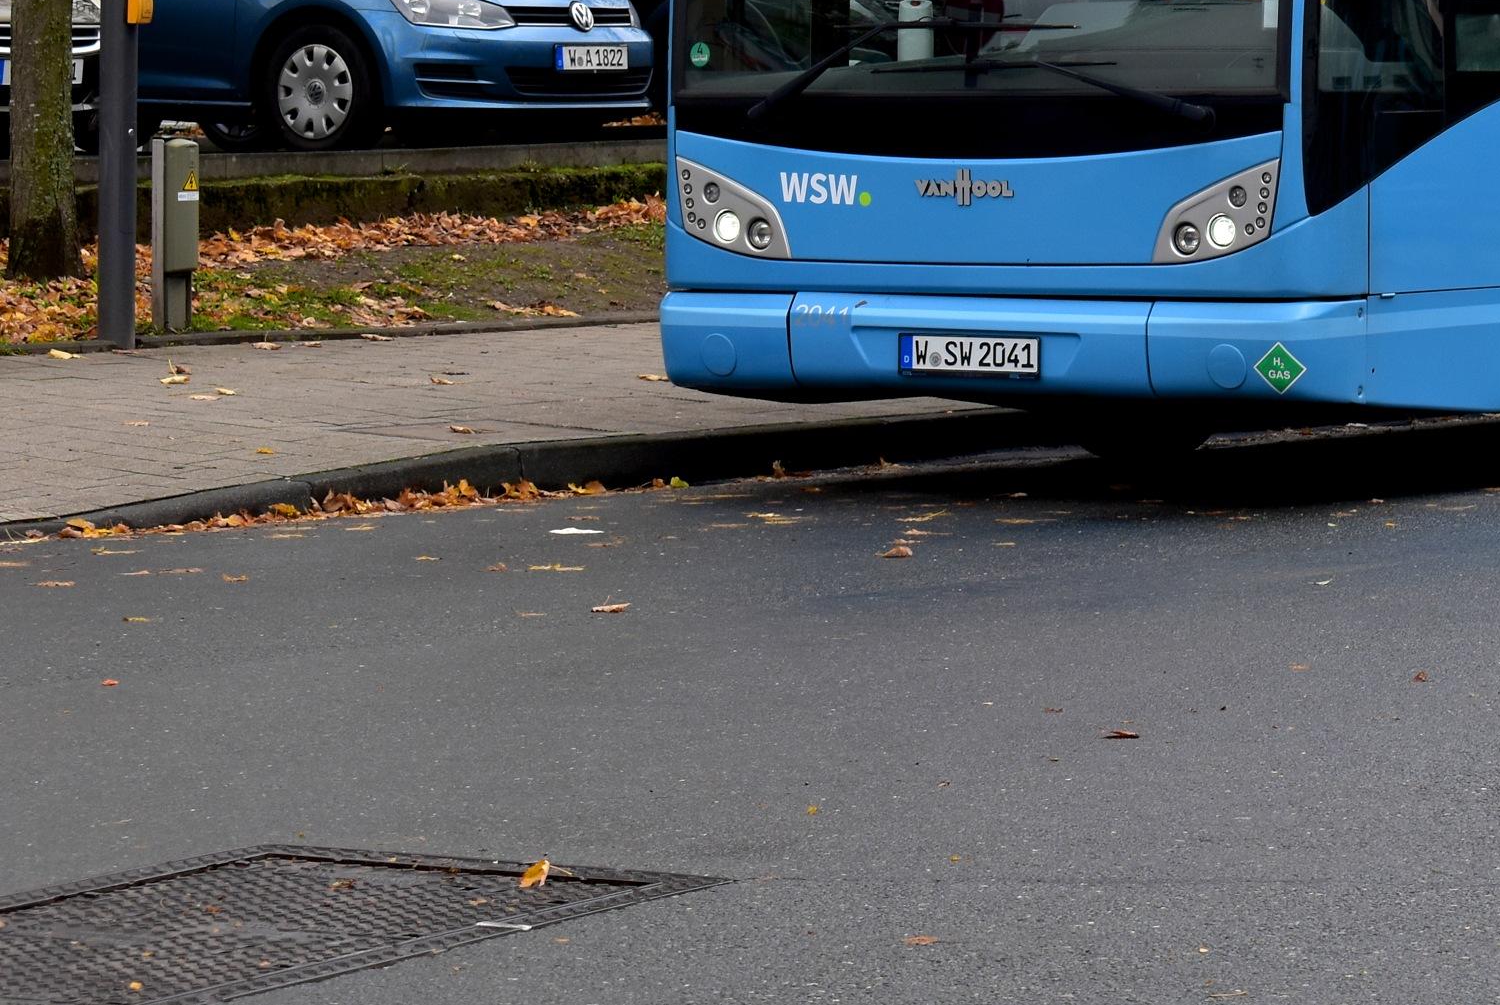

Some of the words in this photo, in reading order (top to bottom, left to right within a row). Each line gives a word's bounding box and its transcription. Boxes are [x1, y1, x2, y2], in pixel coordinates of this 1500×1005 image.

[568, 49, 577, 67] W
[585, 49, 594, 67] A
[595, 49, 624, 67] 1822
[795, 304, 849, 327] 2041
[914, 339, 928, 366] W
[944, 340, 973, 367] SW
[978, 341, 1035, 369] 2041
[1268, 369, 1291, 380] GAS
